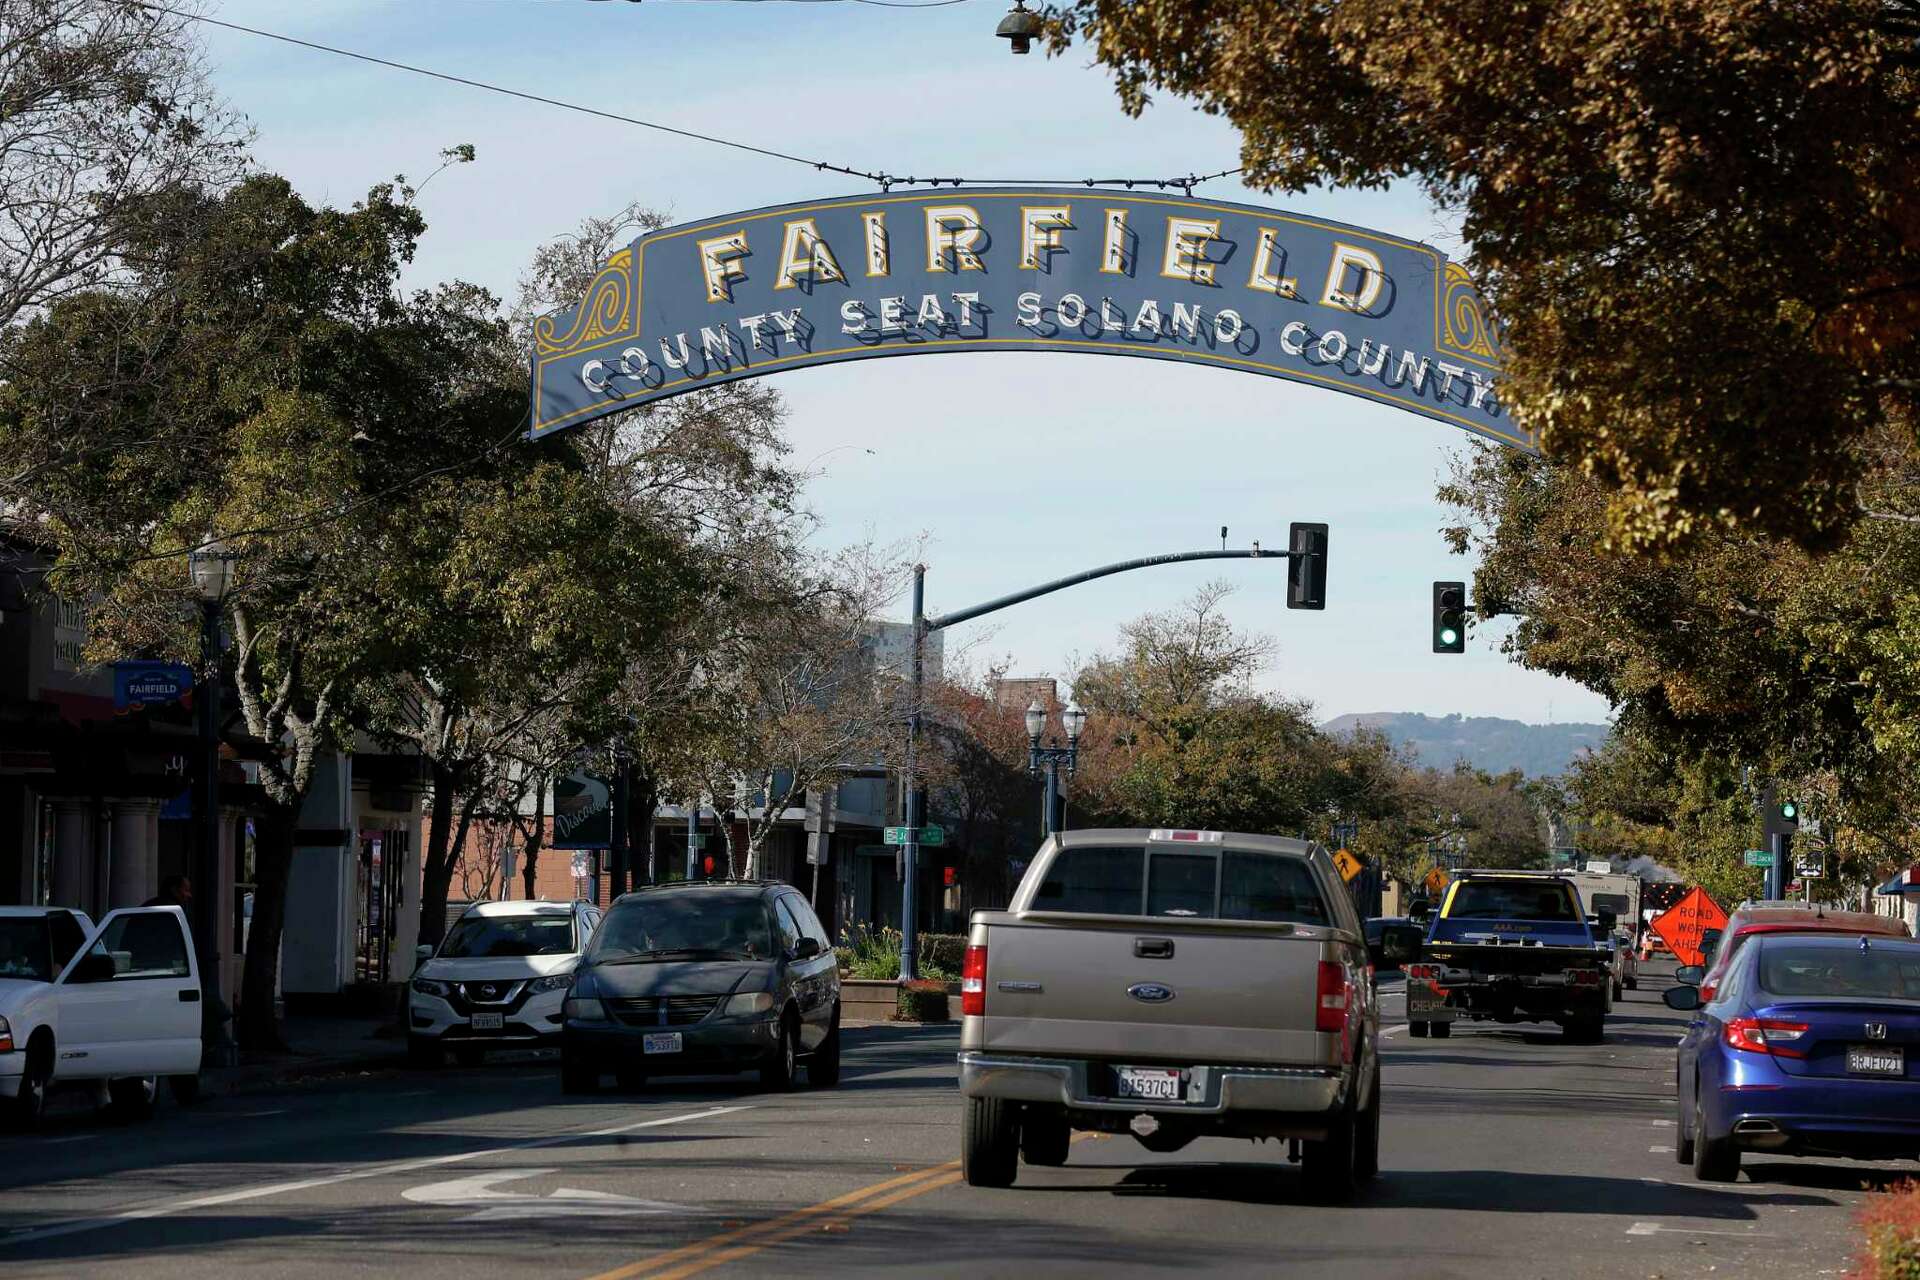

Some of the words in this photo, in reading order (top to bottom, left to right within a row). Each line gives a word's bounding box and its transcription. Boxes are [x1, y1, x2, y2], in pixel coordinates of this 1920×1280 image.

[697, 205, 1386, 314] FAIRFIELD
[581, 307, 802, 394] COUNTY
[840, 291, 980, 334] SEAT
[1016, 291, 1242, 343] SOLANO
[1280, 321, 1496, 409] COUNTY
[129, 684, 177, 694] FAIRFIELD
[1680, 907, 1713, 920] ROAD
